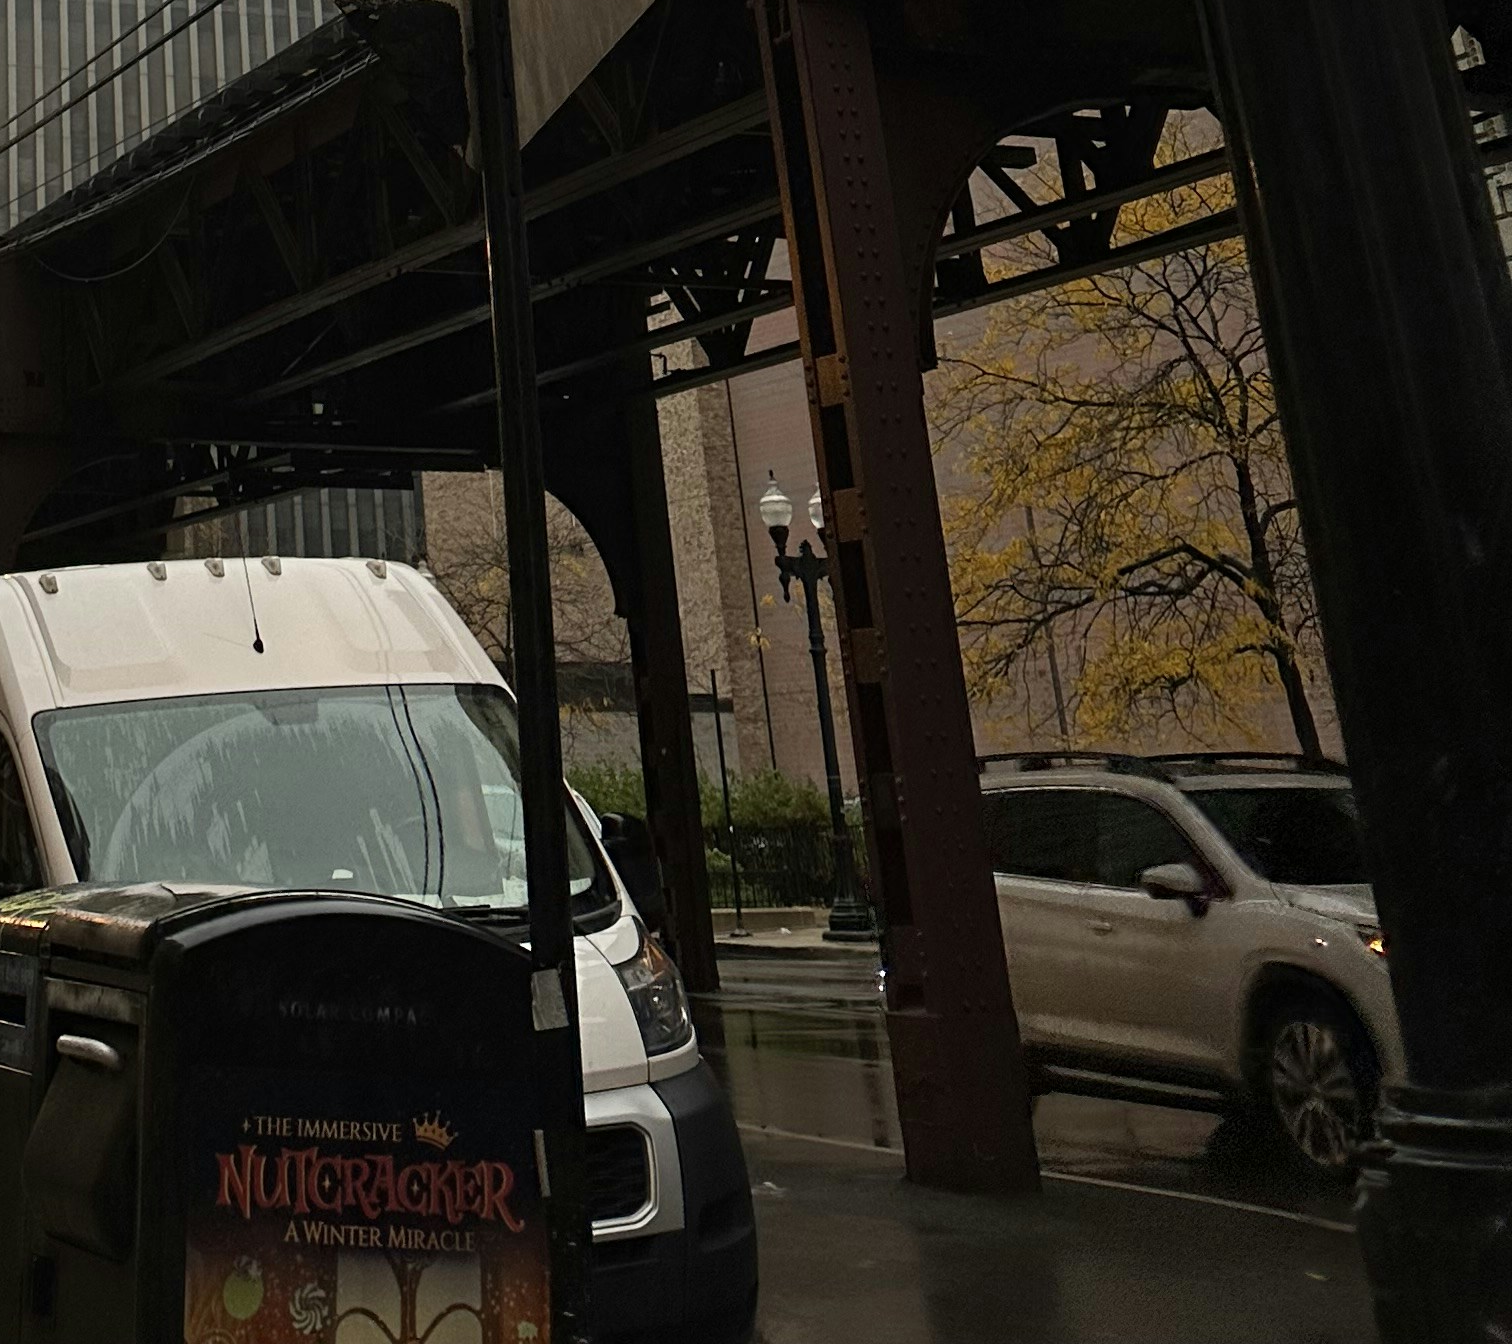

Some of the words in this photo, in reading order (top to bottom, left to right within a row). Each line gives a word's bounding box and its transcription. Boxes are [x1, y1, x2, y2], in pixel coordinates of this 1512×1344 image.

[256, 1116, 293, 1137] THE
[297, 1118, 403, 1143] IMMERSIVE
[215, 1143, 526, 1232] NUTCRACKER
[284, 1223, 300, 1243] A
[300, 1220, 381, 1249] WINTER
[387, 1225, 476, 1252] MIRACLE
